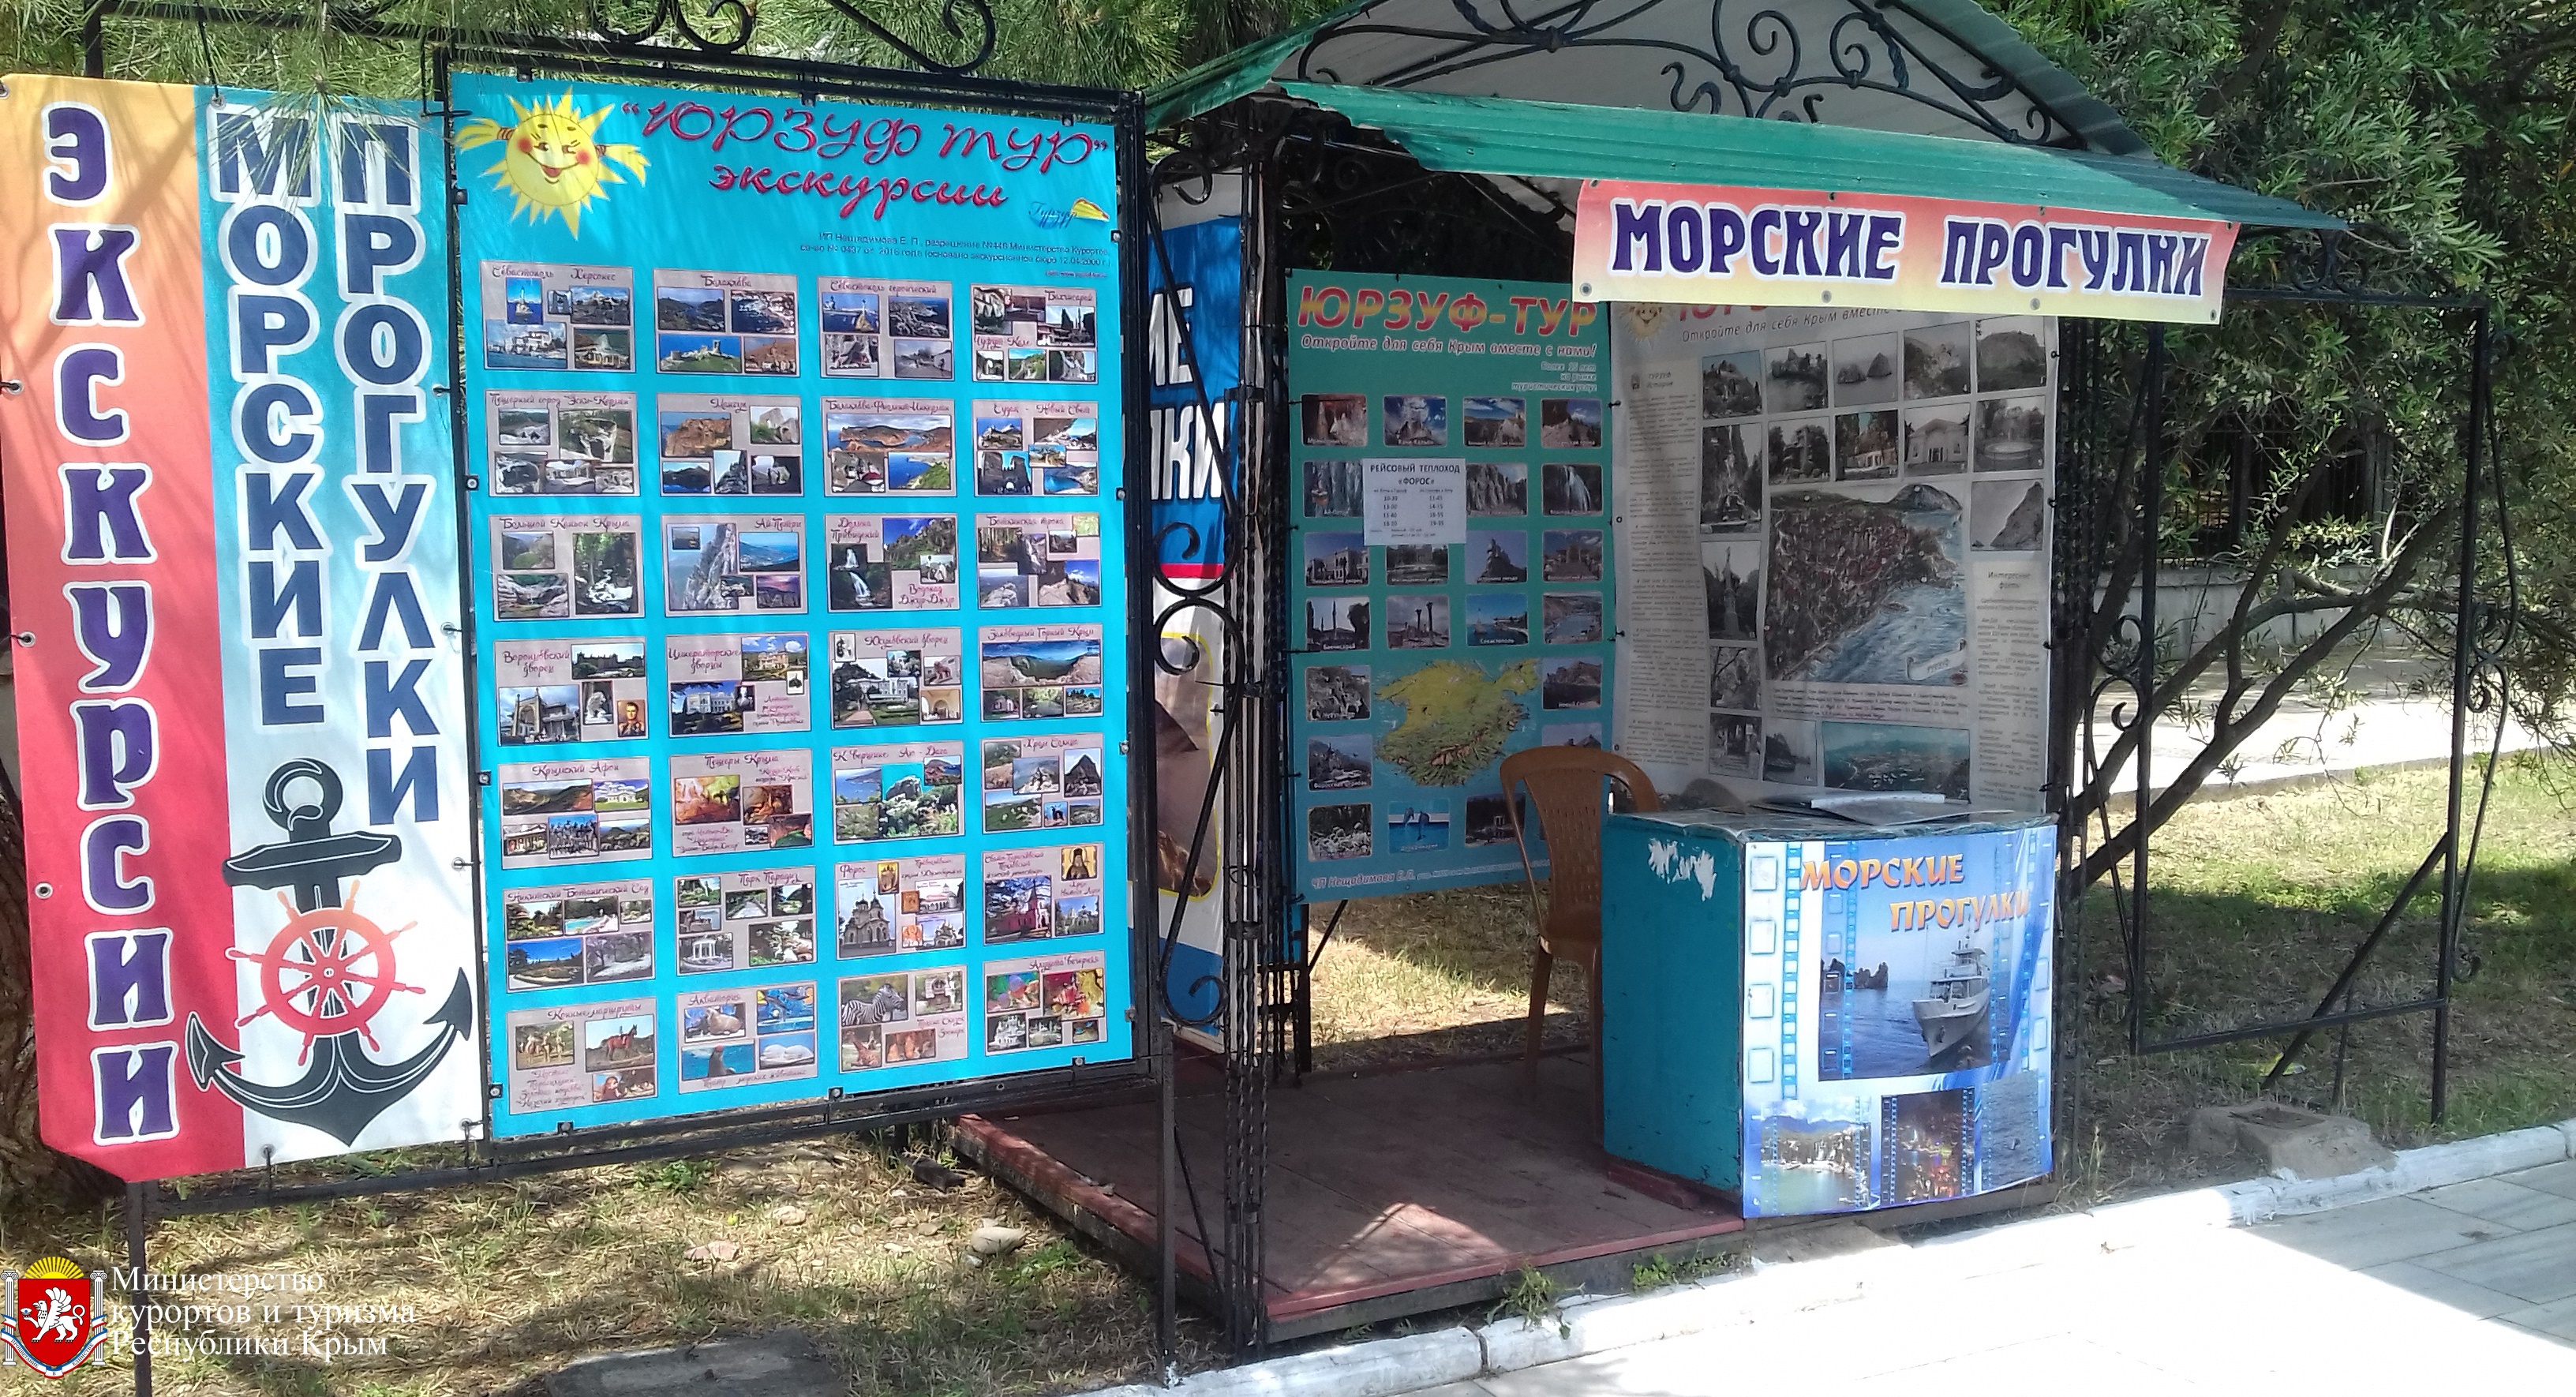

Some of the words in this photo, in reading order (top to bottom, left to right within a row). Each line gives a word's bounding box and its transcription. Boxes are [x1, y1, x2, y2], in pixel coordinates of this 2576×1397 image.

[708, 163, 1008, 221] экскурсии
[1612, 199, 1902, 281] МОРСКИЕ
[1938, 218, 2212, 299] ПРОГУЛКИ
[492, 266, 554, 280] Севастополь
[1297, 285, 1597, 337] ЮРЗУФ-ТУР
[1681, 324, 1741, 343] Откройте
[1745, 321, 1767, 335] для
[1771, 315, 1799, 330] себя
[1803, 310, 1837, 326] Крым
[1300, 333, 1377, 352] Откройте
[1382, 335, 1407, 352] для
[1411, 338, 1443, 354] себя
[1447, 339, 1486, 357] Крым
[1490, 342, 1541, 357] вместе
[1544, 345, 1555, 357] с
[208, 106, 327, 728] МОРСКИЕ
[335, 115, 440, 826] ПРОГУЛКИ
[1370, 463, 1416, 474] РЕЙСОВЫЙ
[1419, 464, 1461, 474] ТЕПЛОХОД
[1398, 477, 1435, 486] «ФОРОС»
[43, 103, 175, 1143] ЭКСКУРСИИ
[1327, 871, 1395, 889] Нещадимова
[1800, 852, 1965, 891] МОРСКИЕ
[1889, 888, 2029, 932] ПРОГУЛКИ
